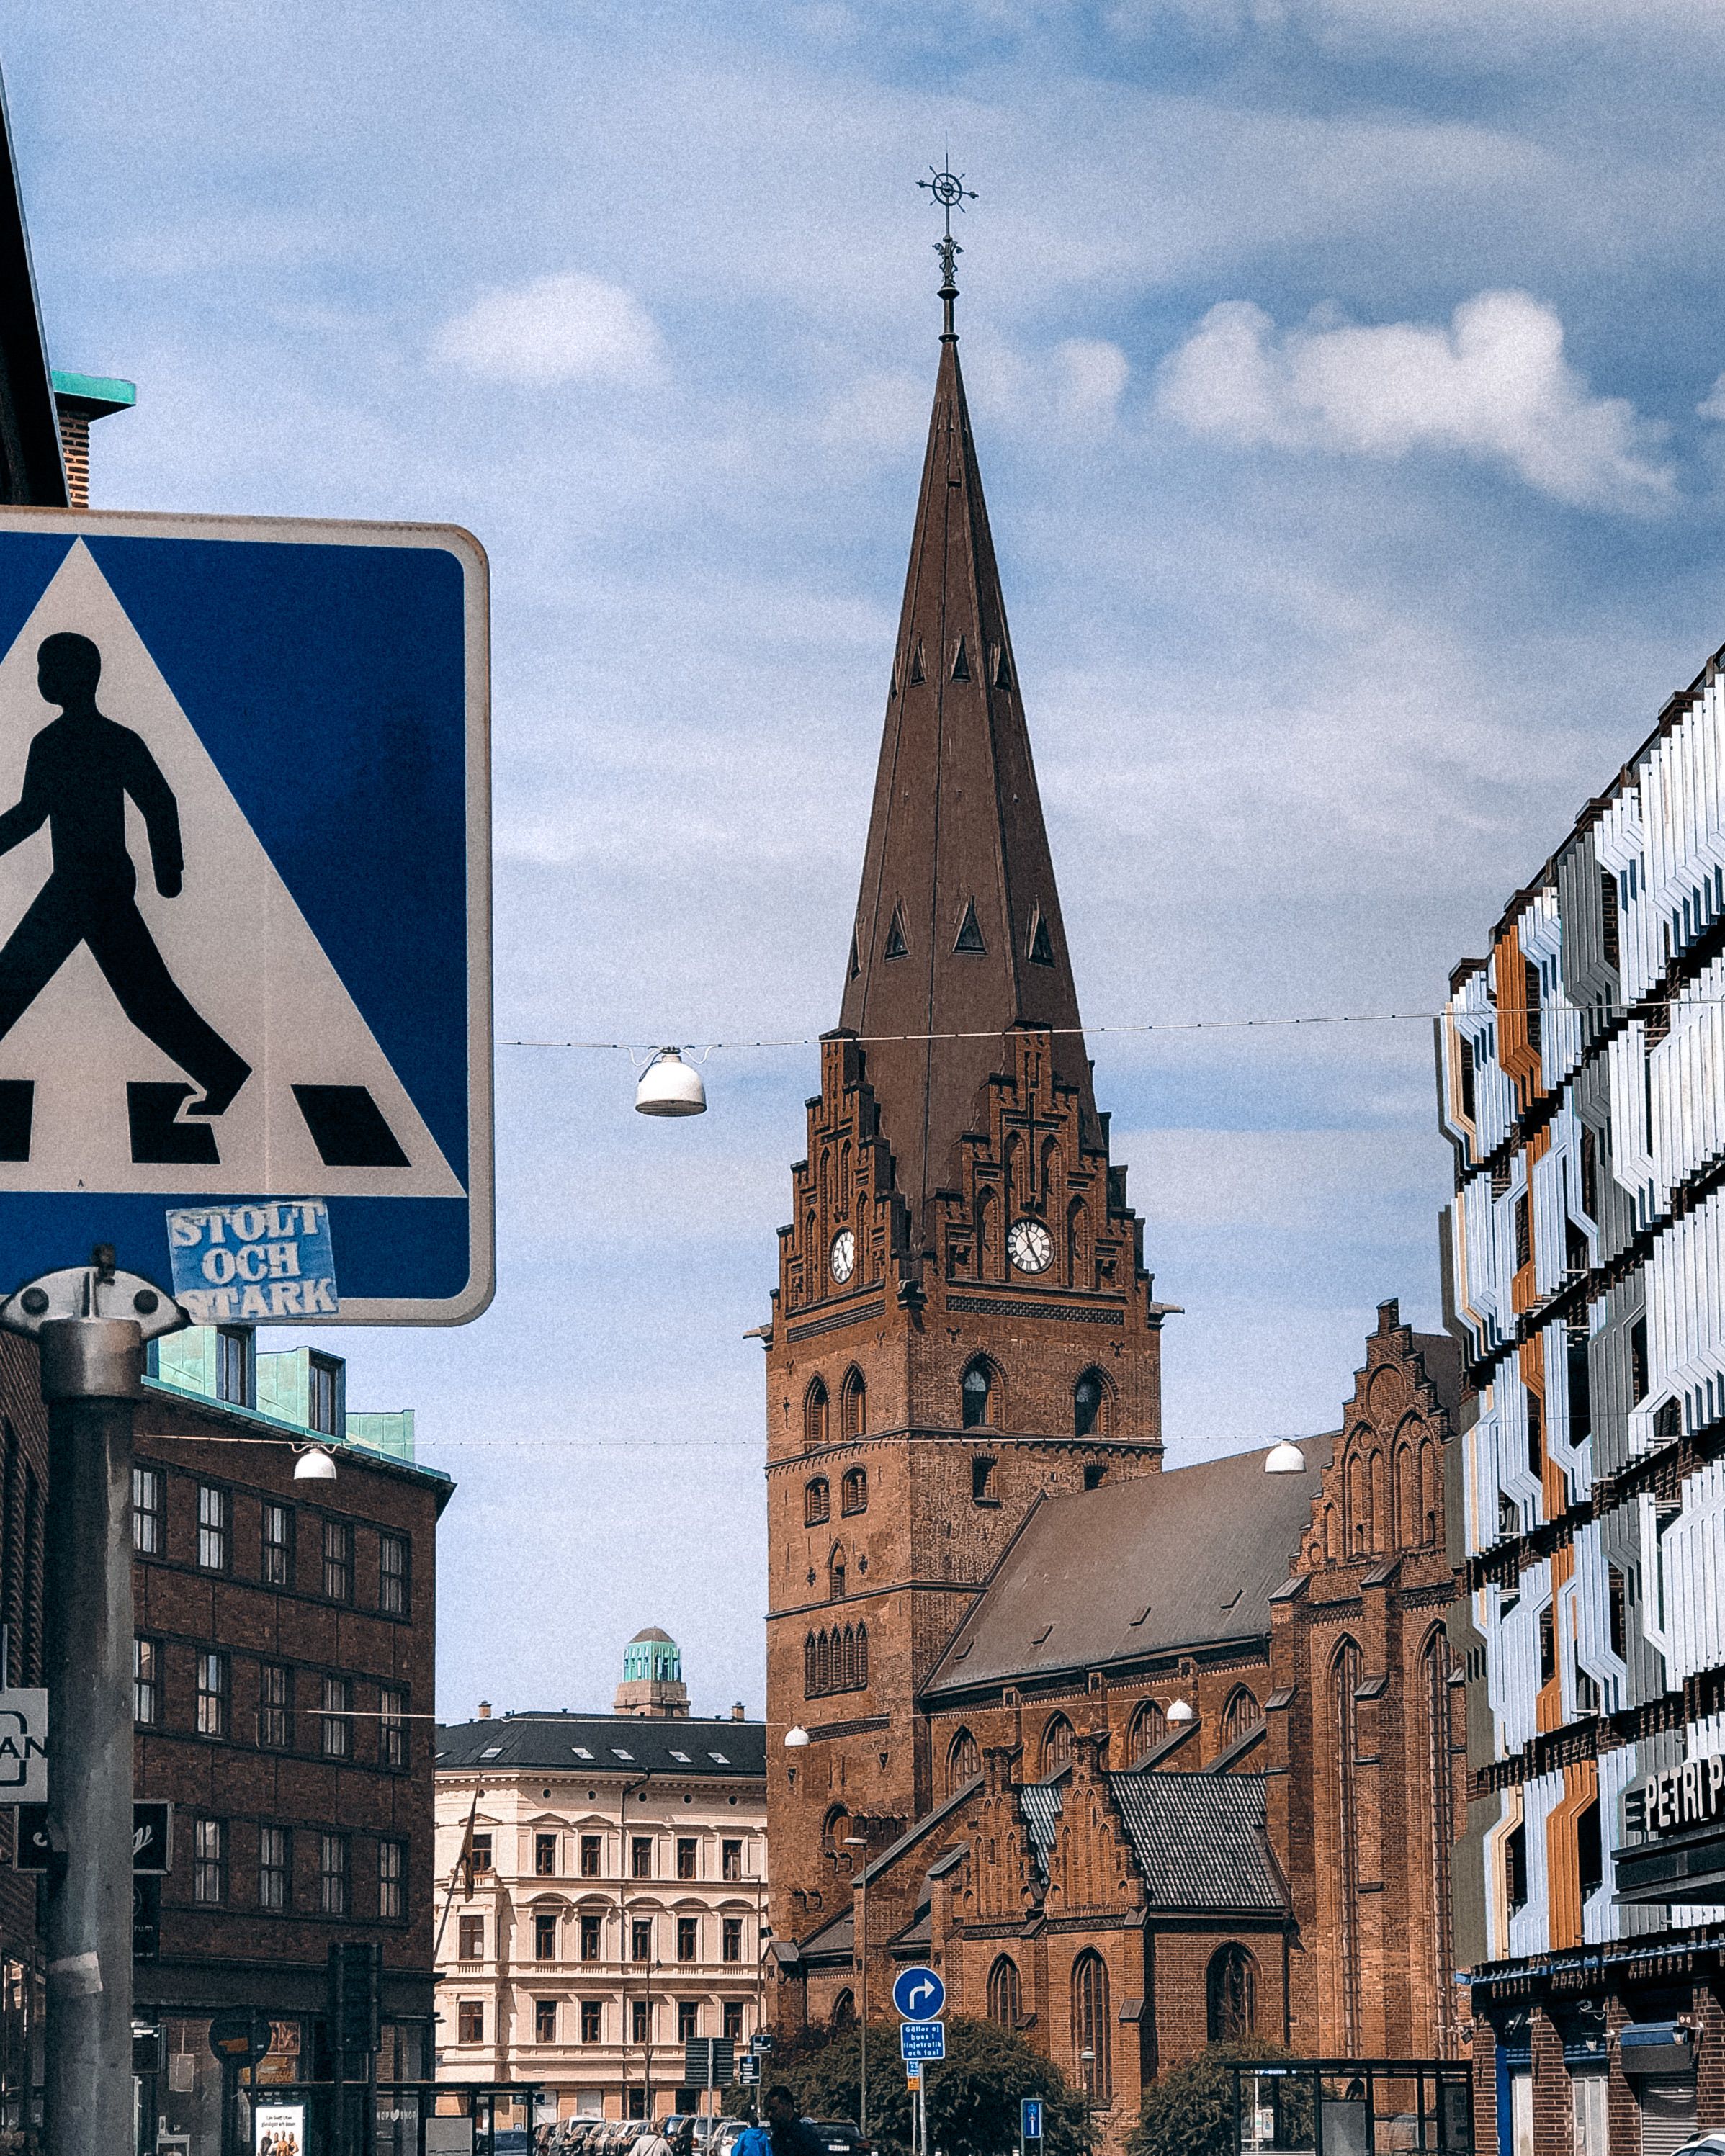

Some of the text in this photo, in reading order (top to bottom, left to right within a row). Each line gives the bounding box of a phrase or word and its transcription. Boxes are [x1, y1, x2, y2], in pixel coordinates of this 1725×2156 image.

[171, 1203, 325, 1247] STOLT
[202, 1242, 301, 1285] OCH
[176, 1278, 339, 1319] STARK
[1645, 1754, 1725, 1831] PETRI P
[903, 2041, 942, 2049] linjetrafik
